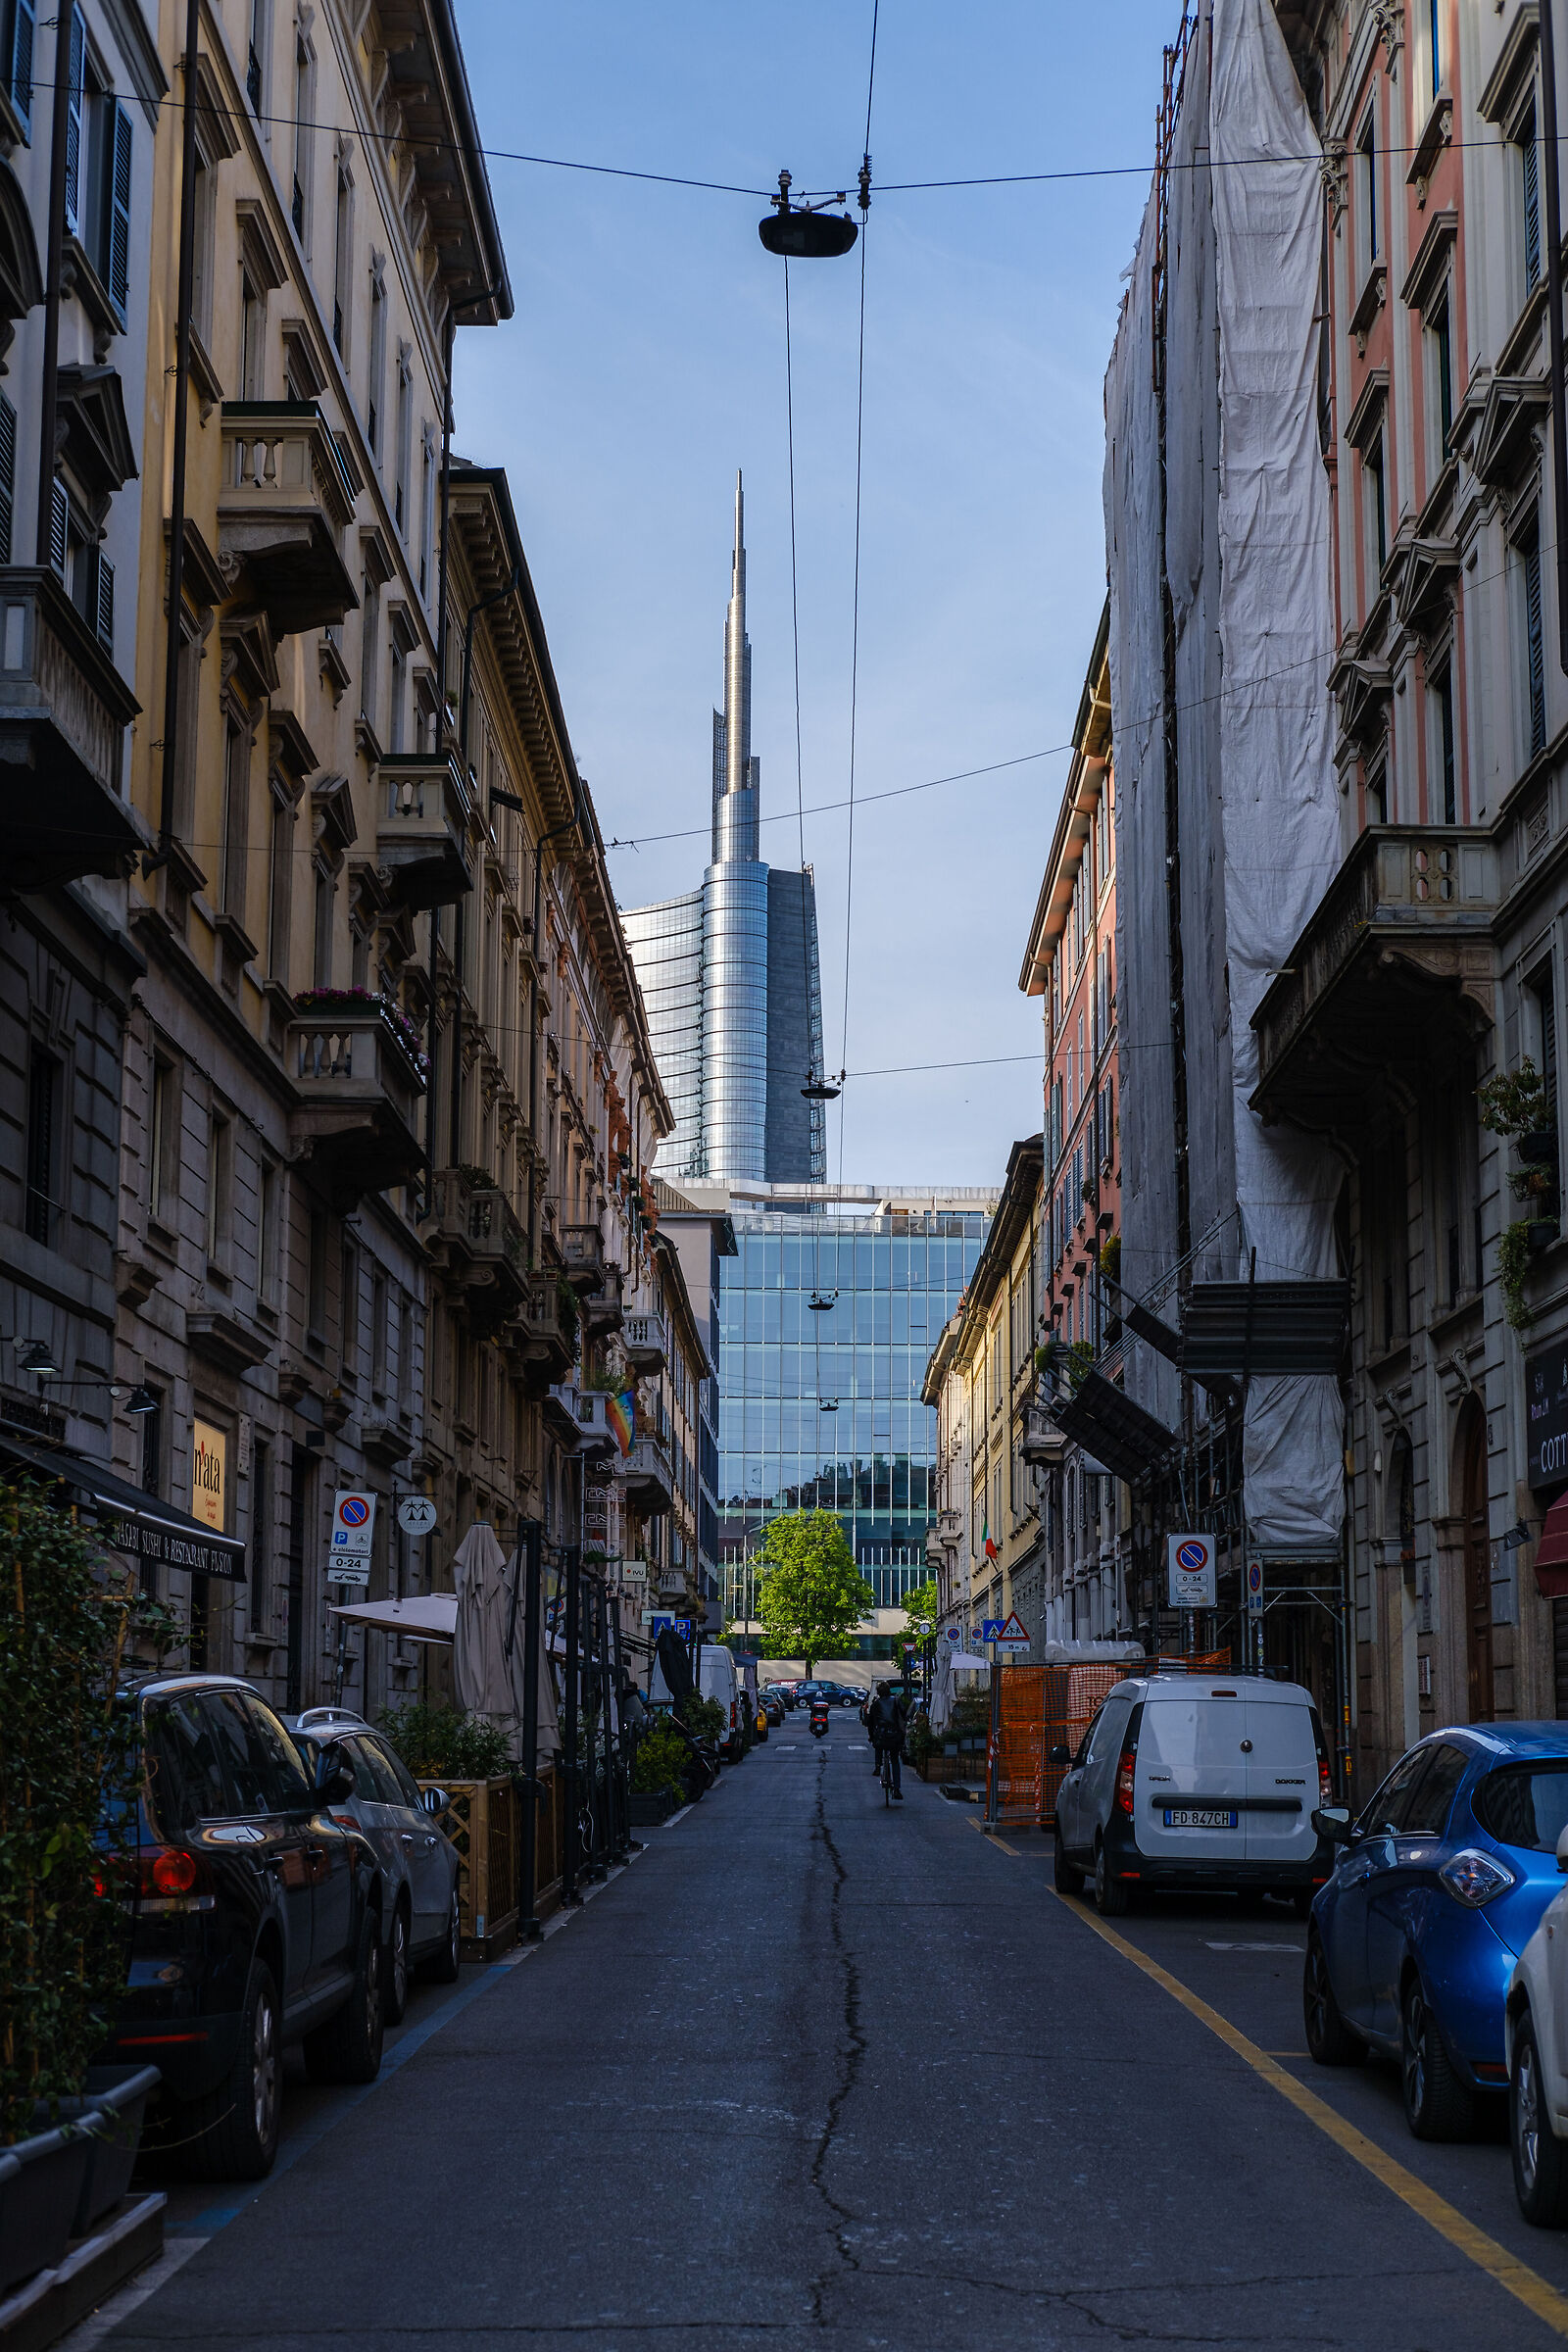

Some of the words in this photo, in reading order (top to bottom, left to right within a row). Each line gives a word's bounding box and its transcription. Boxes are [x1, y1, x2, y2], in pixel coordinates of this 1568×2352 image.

[1541, 1432, 1568, 1474] COTT
[337, 1533, 346, 1544] P
[116, 1521, 140, 1550] ASABI
[142, 1530, 162, 1557] SUSHI
[165, 1537, 170, 1559] &
[171, 1539, 209, 1569] RESTAURANT
[211, 1550, 233, 1575] FUSION
[336, 1557, 362, 1568] 0-24
[1173, 1812, 1188, 1824] FD
[1192, 1812, 1229, 1825] 847CH
